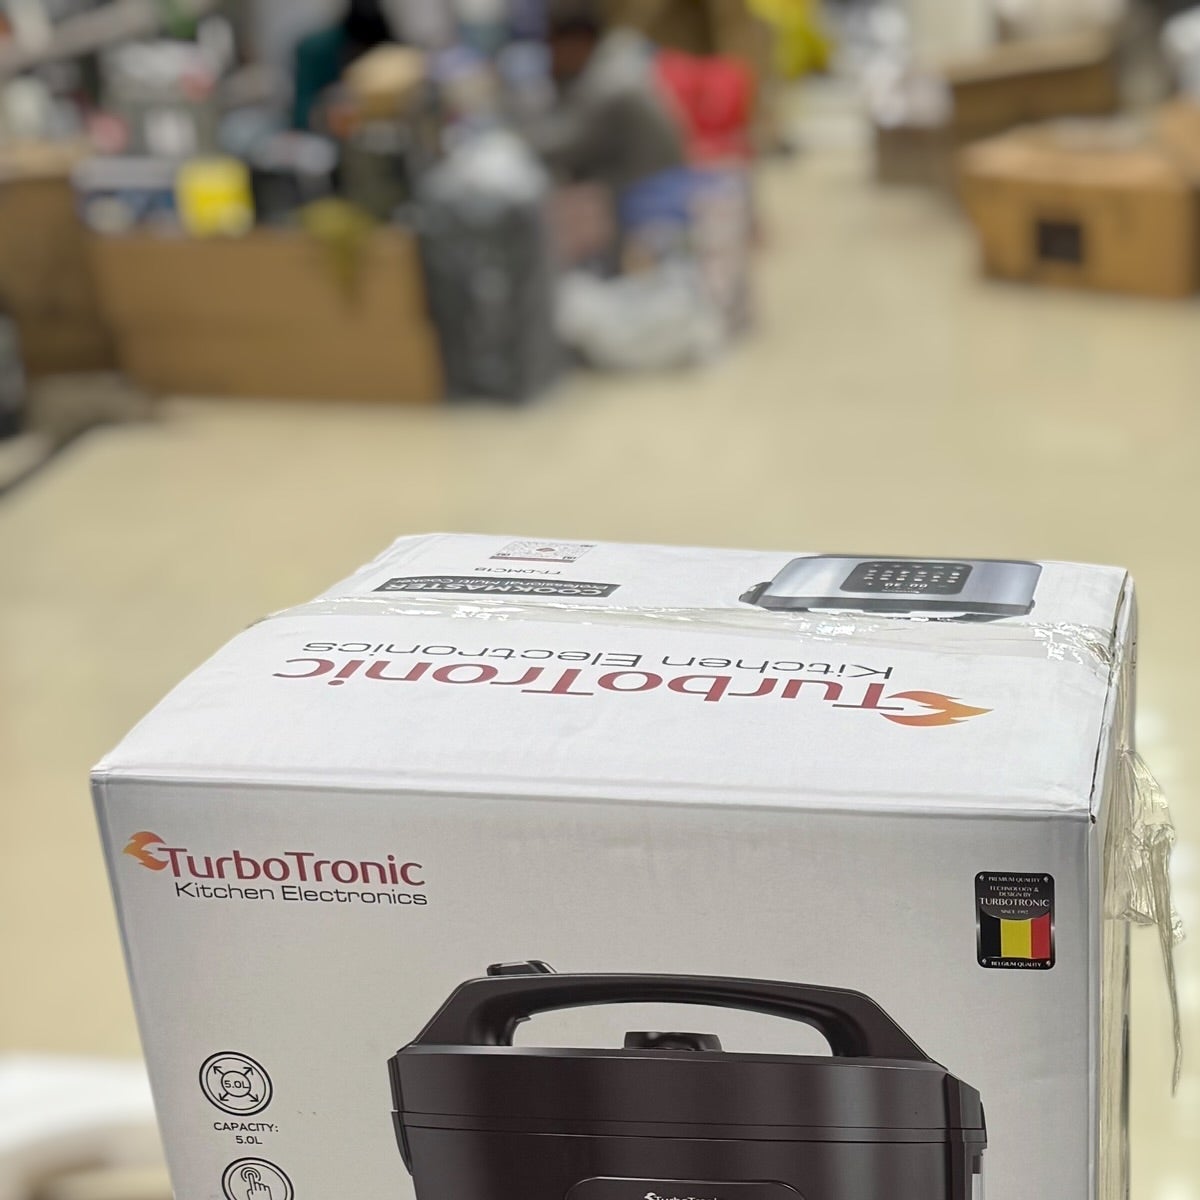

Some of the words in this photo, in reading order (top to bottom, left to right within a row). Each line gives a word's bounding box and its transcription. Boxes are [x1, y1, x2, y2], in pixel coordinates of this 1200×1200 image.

[384, 582, 603, 597] COOKMASTER
[302, 641, 644, 668] Electronics
[662, 655, 893, 680] Kitchen
[272, 657, 904, 711] TurboTronic
[157, 847, 426, 886] TurboTronic
[175, 881, 275, 901] Kitchen
[281, 885, 428, 906] Electronics
[979, 897, 1050, 907] TURBOTRONIC
[224, 1079, 250, 1089] 5.0L
[213, 1122, 279, 1132] CAPACITY:
[236, 1135, 263, 1145] 5.0L
